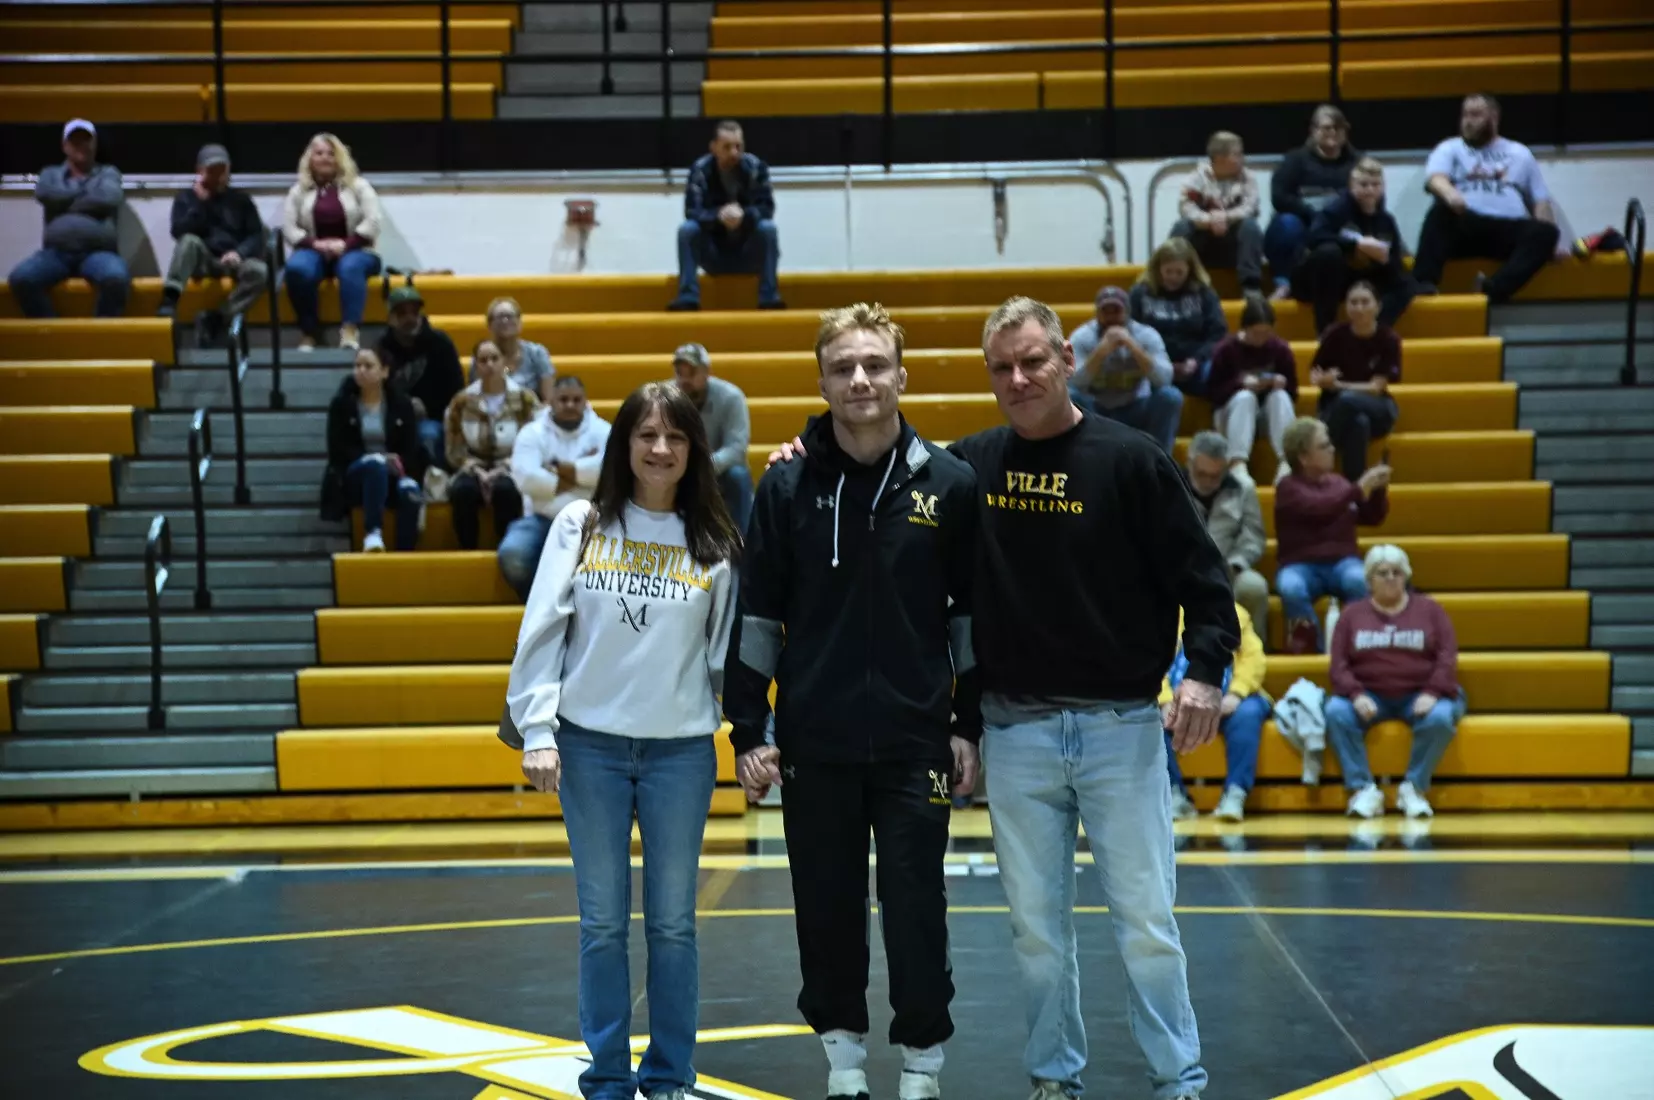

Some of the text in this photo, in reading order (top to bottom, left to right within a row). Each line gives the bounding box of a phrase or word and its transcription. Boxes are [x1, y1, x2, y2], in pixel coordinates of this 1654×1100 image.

[1006, 470, 1068, 499] VILLE
[986, 493, 1083, 514] WRESTLING
[580, 533, 713, 592] ILLERSVILLE
[586, 570, 692, 602] UNIVERSITY
